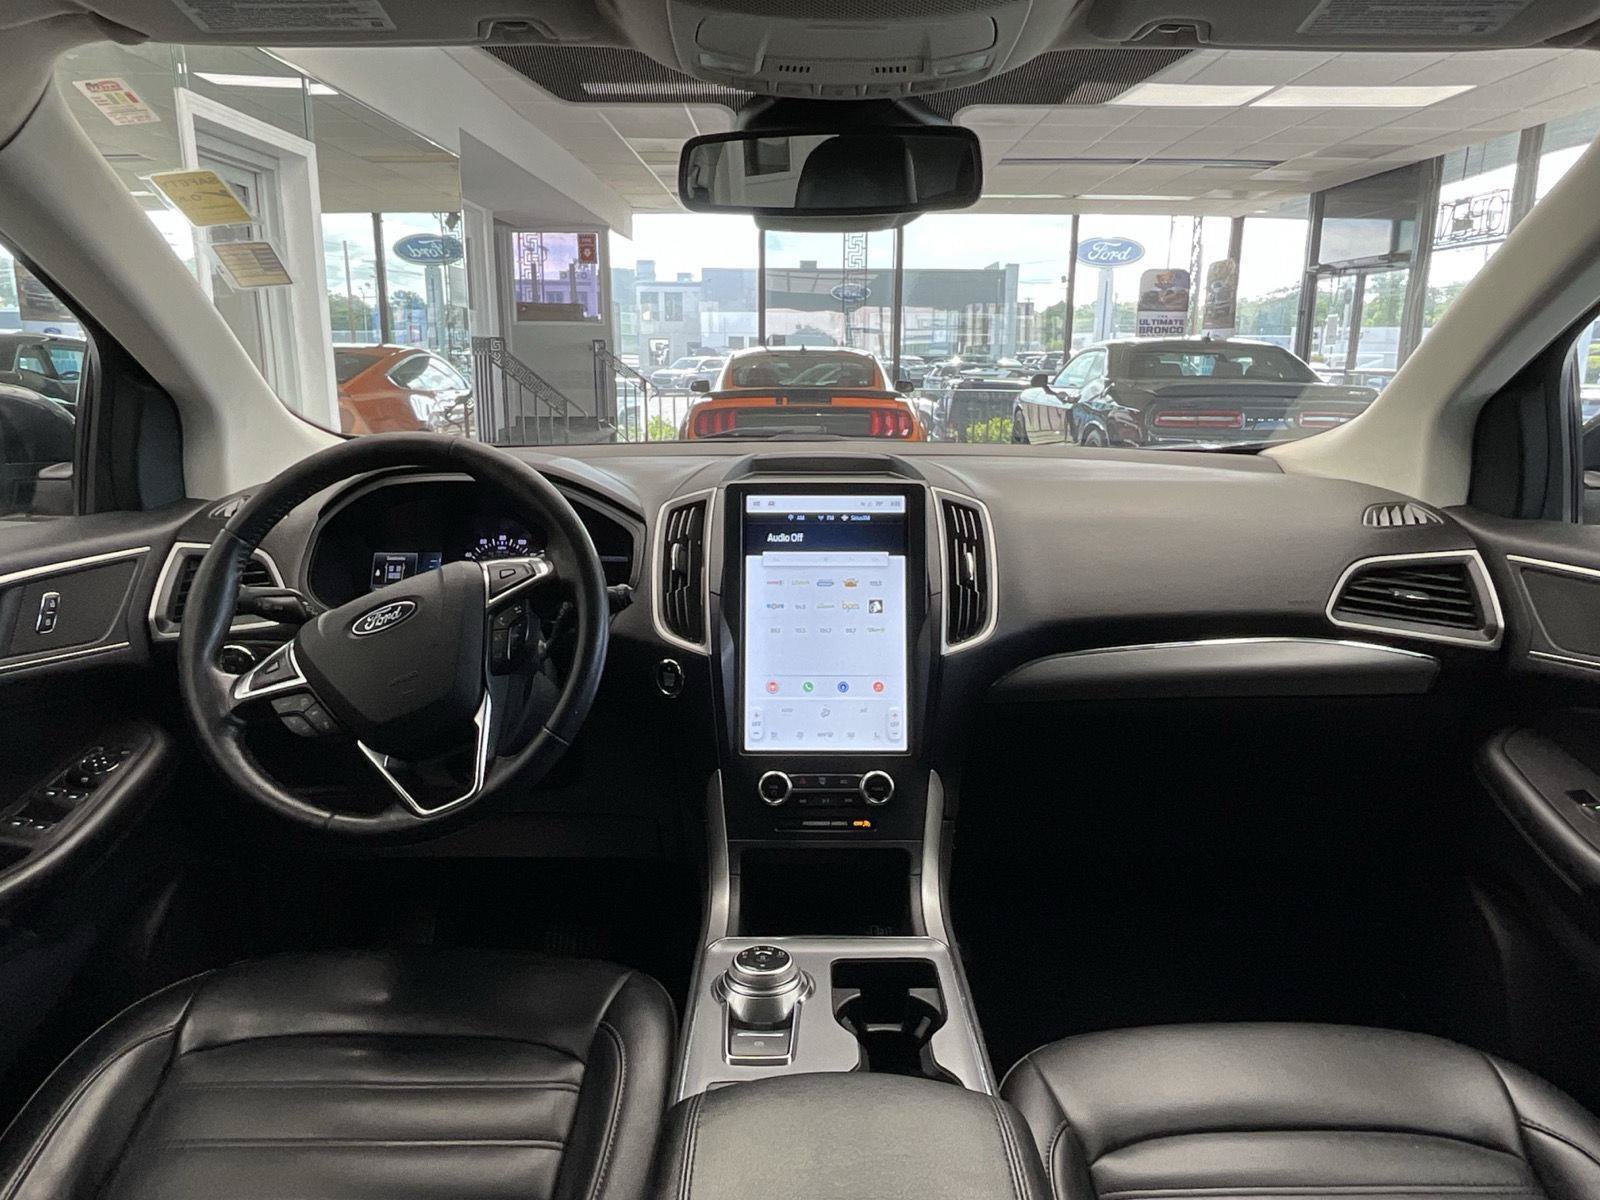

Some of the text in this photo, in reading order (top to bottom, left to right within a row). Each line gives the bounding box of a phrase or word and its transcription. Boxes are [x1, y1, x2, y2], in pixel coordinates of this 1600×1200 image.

[1088, 241, 1132, 260] Ford
[1139, 318, 1184, 326] ULTIMATE
[1139, 326, 1184, 334] BRONCO
[766, 532, 804, 542] Audio Off
[364, 605, 402, 630] Ford
